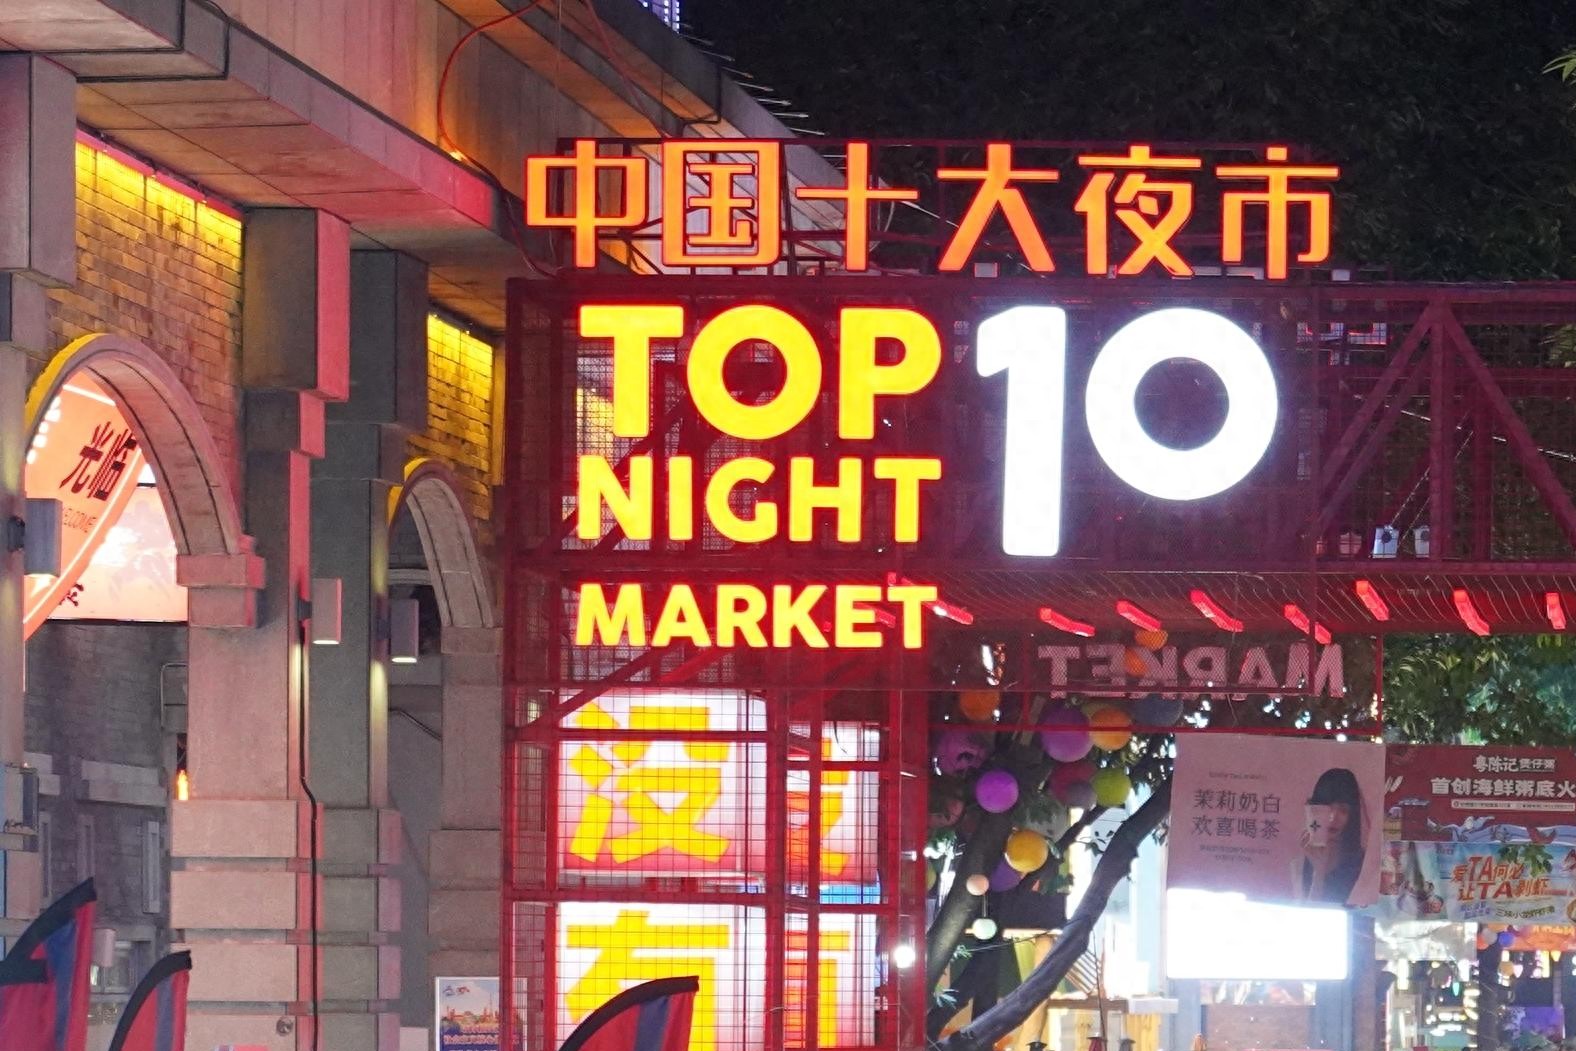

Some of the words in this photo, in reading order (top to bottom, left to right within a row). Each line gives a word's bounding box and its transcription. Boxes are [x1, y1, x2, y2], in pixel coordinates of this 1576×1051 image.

[525, 139, 1341, 280] 中国十大夜市
[578, 304, 943, 441] TOP
[976, 304, 1279, 558] 10
[576, 455, 943, 543] NIGHT
[575, 582, 938, 649] MARKET
[1191, 814, 1281, 840] 欢喜喝茶
[1193, 787, 1281, 814] 茉莉奶白
